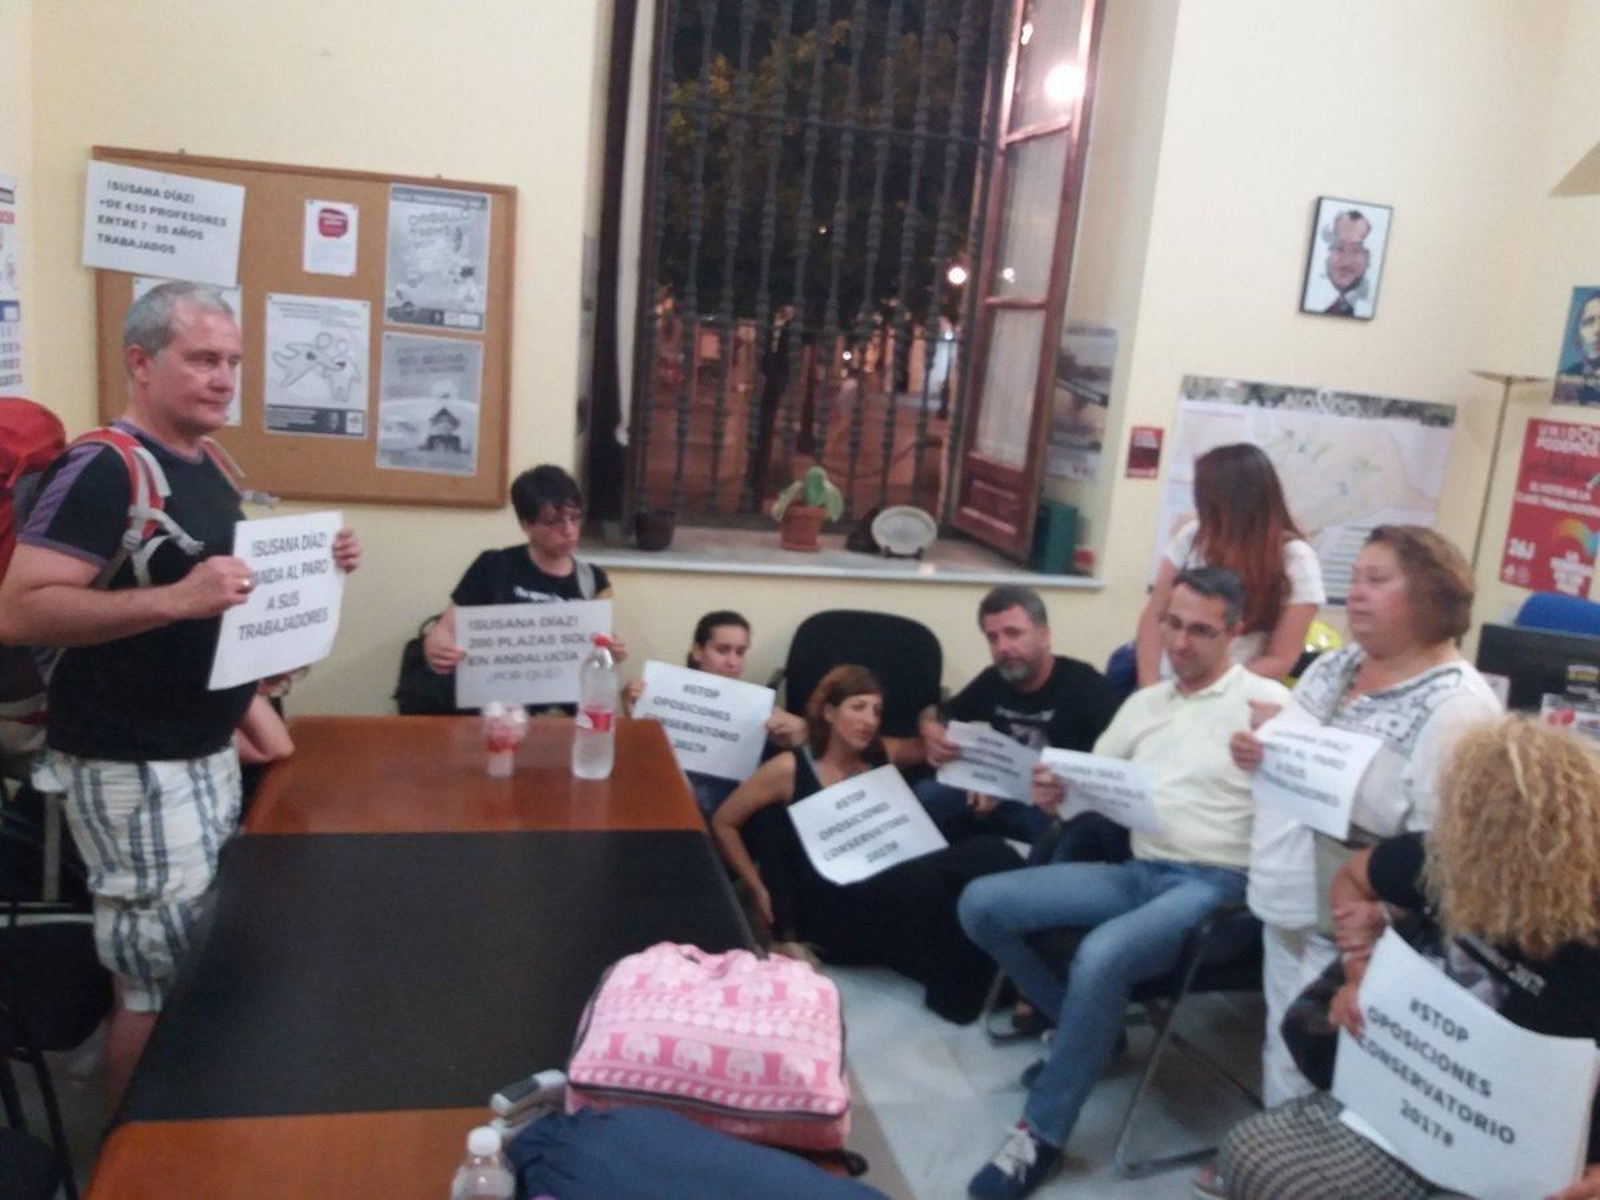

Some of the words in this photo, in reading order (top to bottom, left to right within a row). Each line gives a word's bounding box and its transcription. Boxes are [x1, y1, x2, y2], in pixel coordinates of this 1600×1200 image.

[97, 214, 138, 229] ENTRE
[171, 226, 204, 240] AÑOS
[149, 205, 228, 227] PROFESORES
[97, 233, 176, 255] TRABAJADOS
[286, 567, 300, 581] AL
[302, 558, 329, 577] PARO
[266, 597, 275, 612] A
[277, 590, 300, 610] SUS
[238, 607, 330, 641] TRABAJADORES
[497, 633, 557, 648] PLAZAS
[468, 653, 489, 667] EN
[653, 695, 732, 722] OPOSICIONES
[818, 801, 891, 841] OPOSICIONES
[821, 813, 910, 861] CONSERVATORIO
[1408, 997, 1470, 1043] #STOP
[1367, 1004, 1493, 1098] OPOSICIONES
